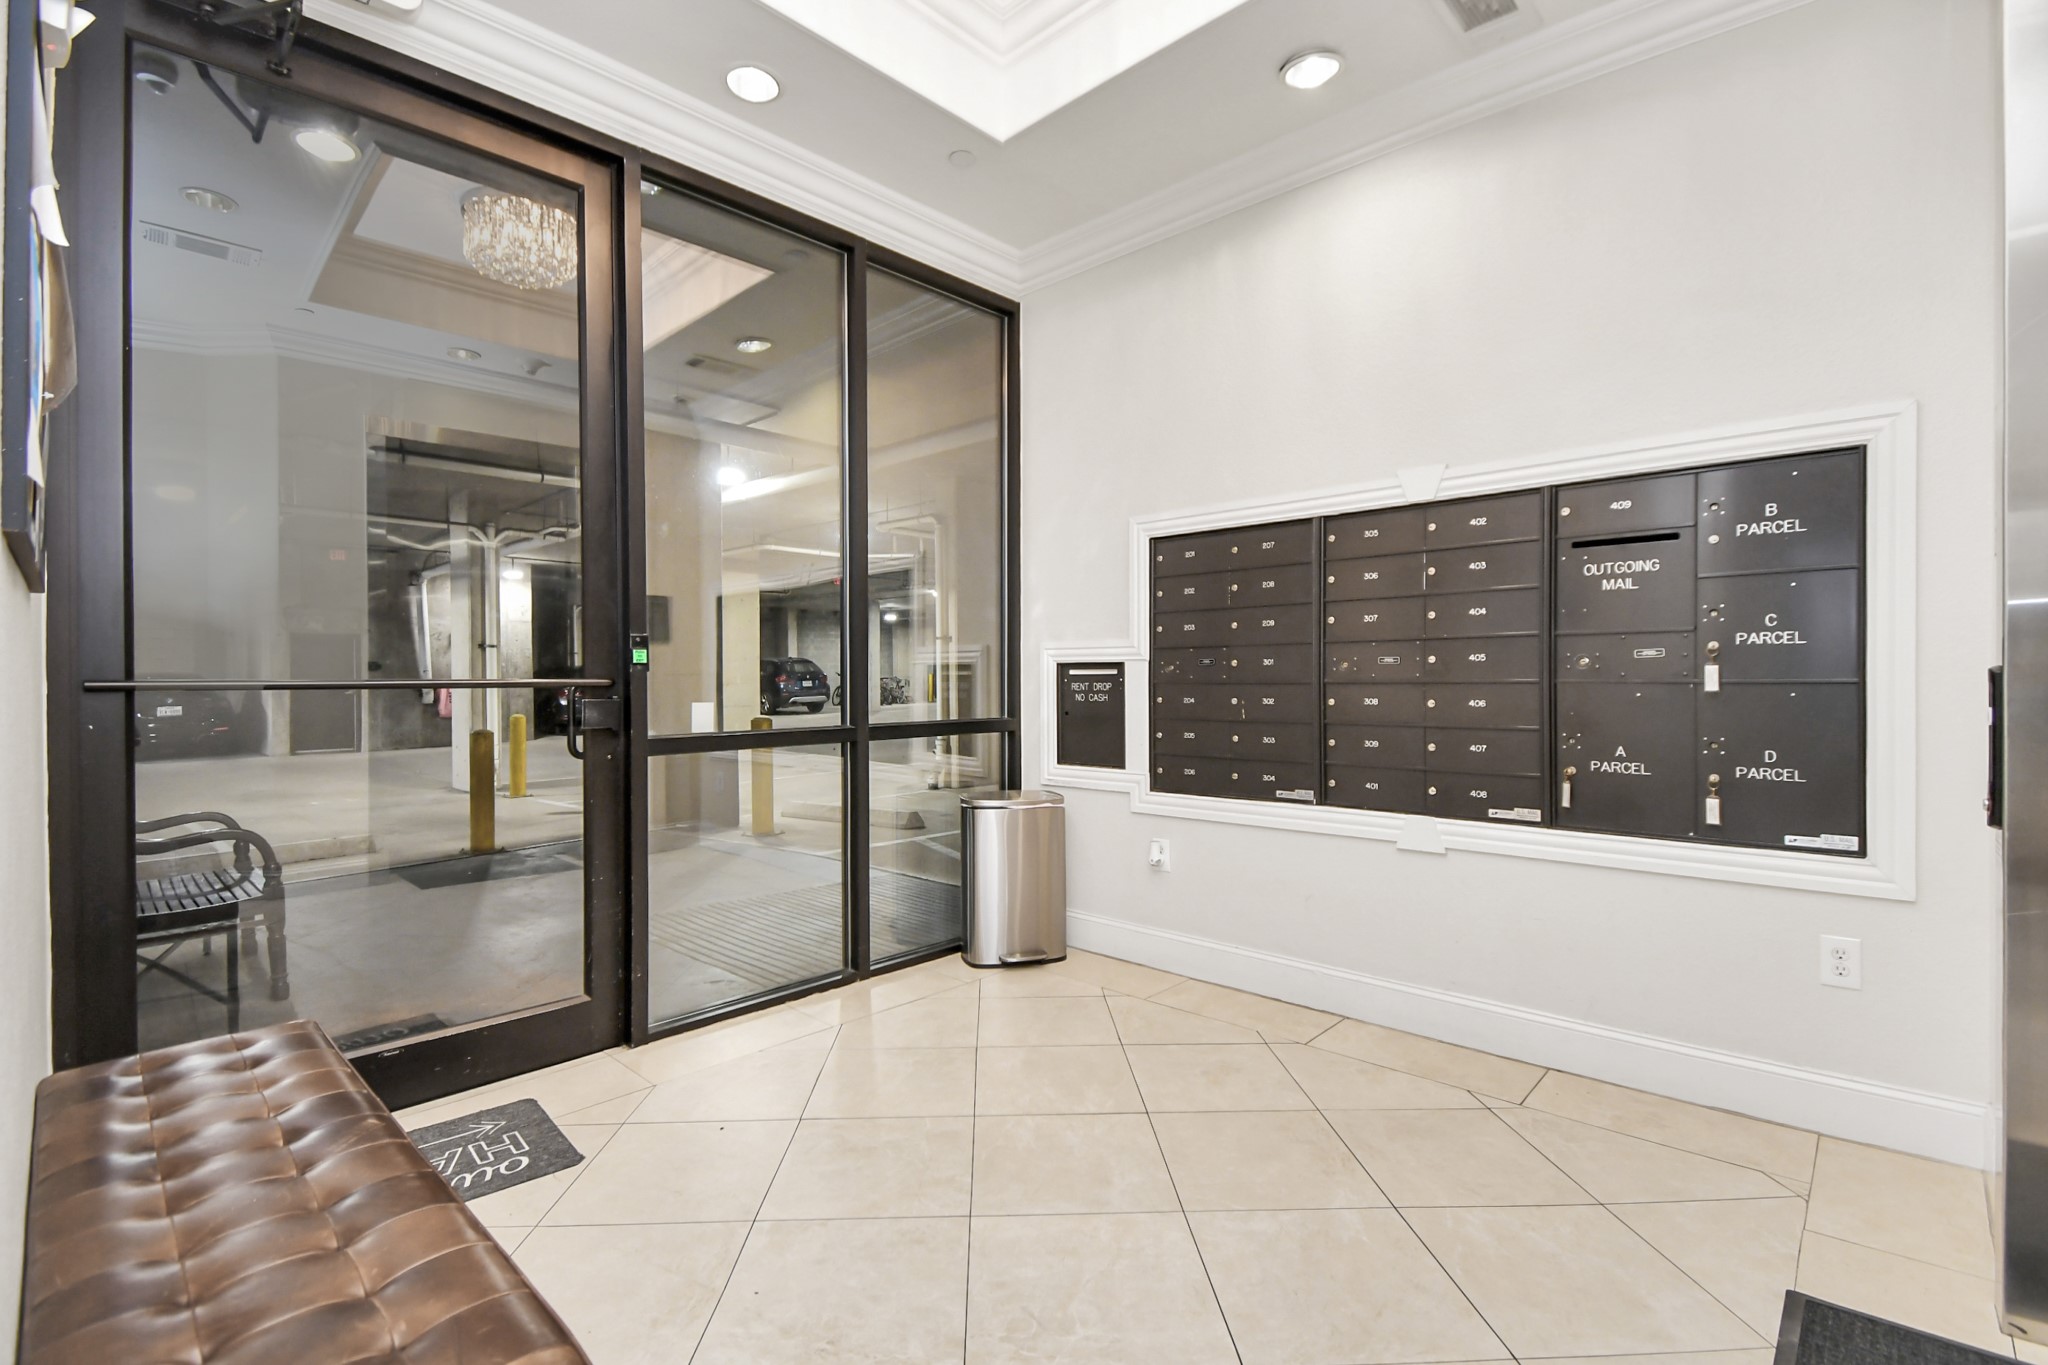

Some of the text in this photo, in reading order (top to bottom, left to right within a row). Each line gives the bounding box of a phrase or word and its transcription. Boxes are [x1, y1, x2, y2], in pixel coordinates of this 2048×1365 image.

[1609, 499, 1632, 510] 409
[1765, 503, 1777, 516] B
[1469, 516, 1488, 526] 402
[1736, 519, 1807, 536] PARCEL
[1363, 529, 1379, 538] 305
[1262, 541, 1276, 550] 207
[1184, 550, 1196, 559] 201
[1468, 561, 1487, 570] 403
[1584, 559, 1659, 576] OUTGOING
[1363, 571, 1379, 581] 306
[1262, 580, 1275, 589] 208
[1602, 578, 1639, 590] MAIL
[1183, 587, 1196, 595] 202
[1468, 607, 1487, 616] 404
[1261, 619, 1275, 627] 209
[1363, 614, 1379, 623] 307
[1765, 614, 1777, 626] C
[1183, 623, 1196, 632] 203
[1736, 631, 1807, 644] PARCEL
[1262, 658, 1274, 666] 301
[1468, 653, 1487, 662] 405
[1071, 682, 1112, 692] RENT DROP
[1075, 692, 1108, 702] NO CASH
[1262, 697, 1275, 705] 302
[1363, 697, 1379, 706] 308
[1468, 699, 1487, 708] 406
[1183, 731, 1196, 739] 205
[1262, 736, 1276, 744] 303
[1364, 739, 1379, 748] 309
[1469, 744, 1488, 753] 407
[1615, 746, 1626, 757] A
[1765, 750, 1776, 762] D
[1183, 768, 1196, 776] 206
[1591, 761, 1651, 775] PARCEL
[1262, 774, 1276, 782] 304
[1736, 767, 1806, 782] PARCEL
[1365, 782, 1379, 790] 401
[1469, 789, 1488, 799] 408
[430, 1131, 530, 1176] HA
